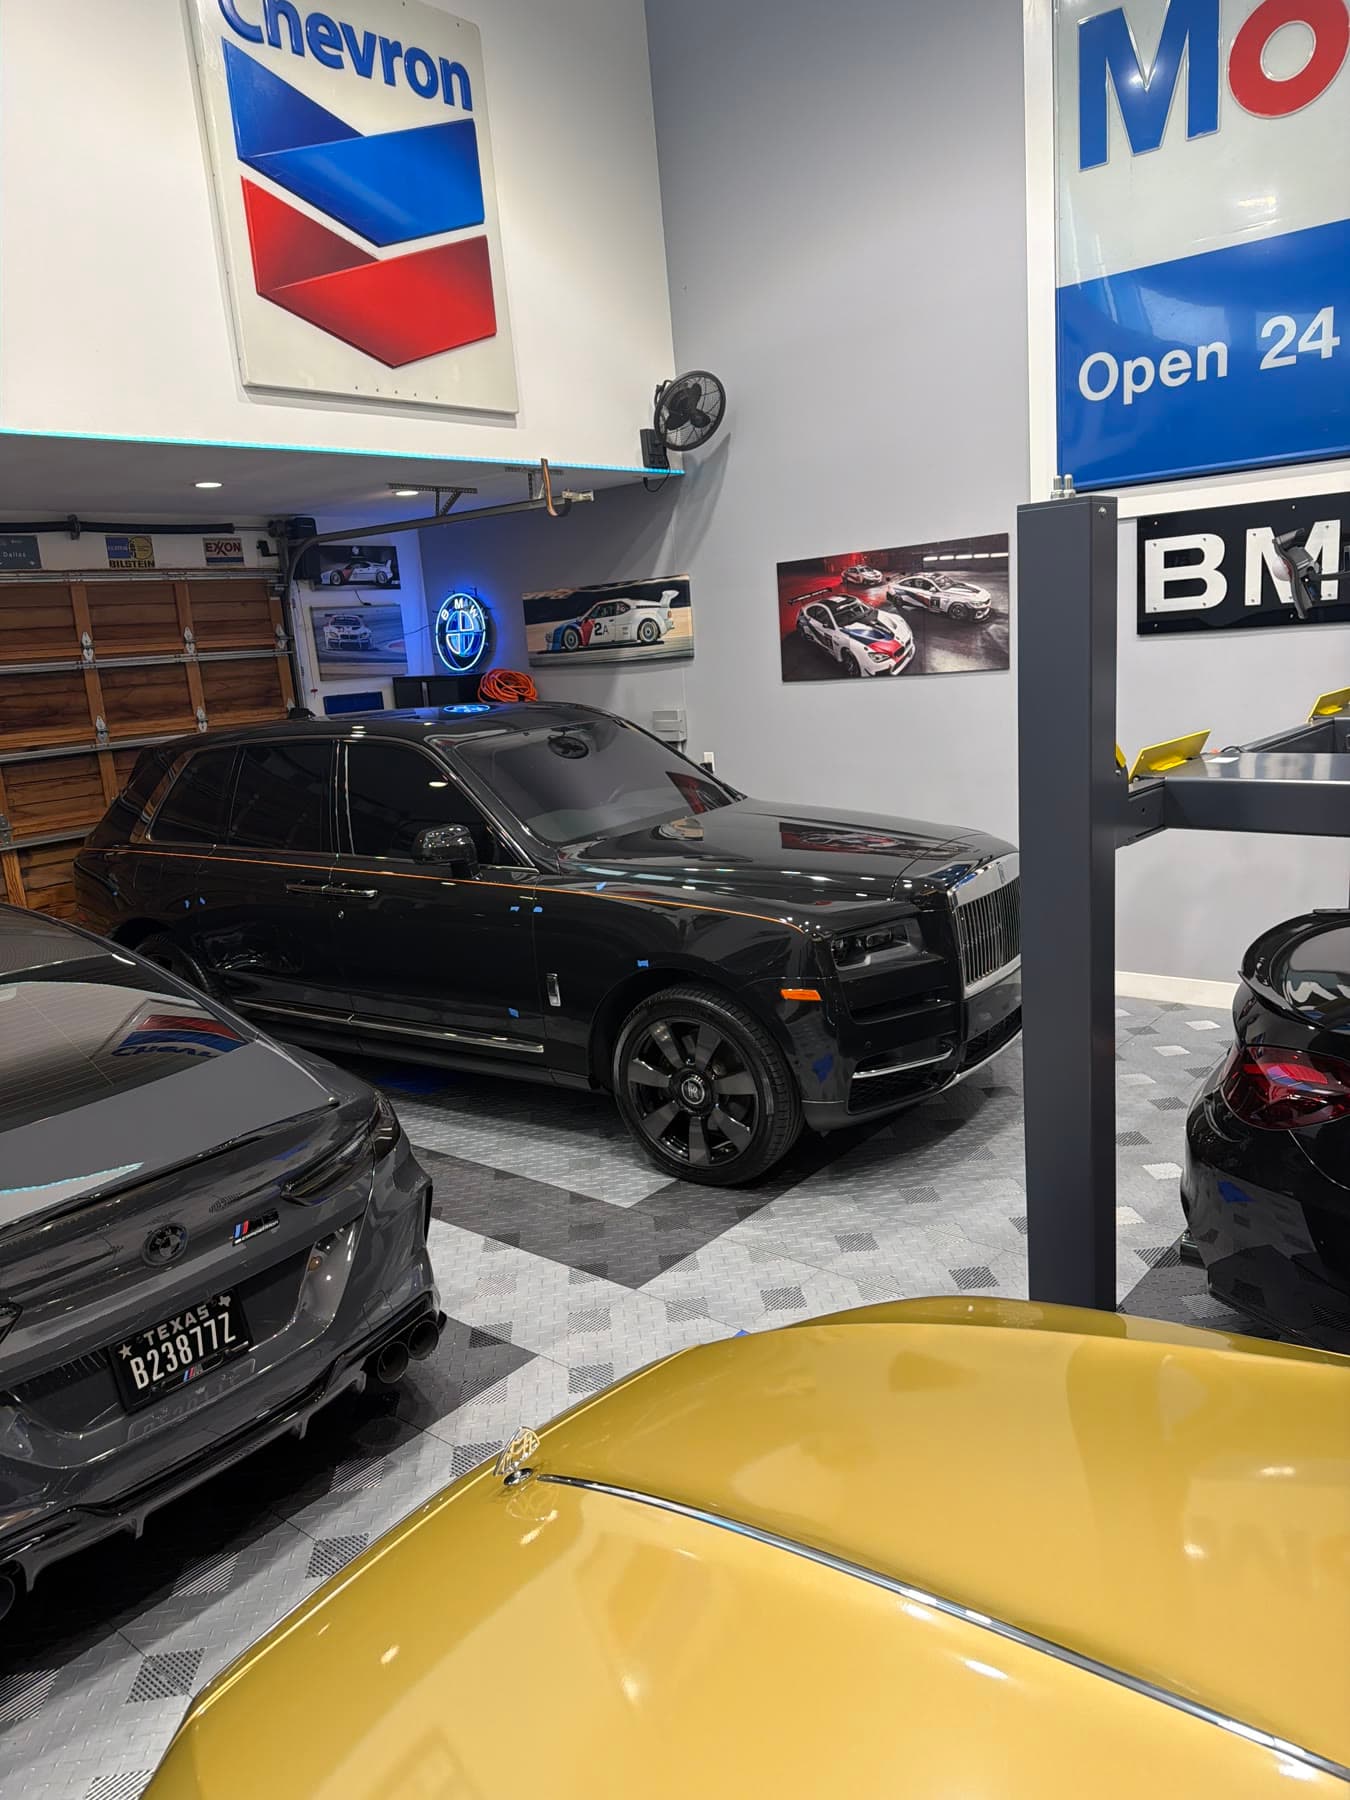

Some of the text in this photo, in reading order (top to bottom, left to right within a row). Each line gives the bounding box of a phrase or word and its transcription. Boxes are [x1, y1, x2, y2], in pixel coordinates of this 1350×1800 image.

[217, 0, 473, 112] Chevron
[1078, 306, 1341, 406] Open 24
[109, 559, 155, 569] BILSTEIN
[205, 541, 241, 556] EXXON
[129, 1312, 236, 1390] B23877Z
[143, 1304, 210, 1346] TEXAS
